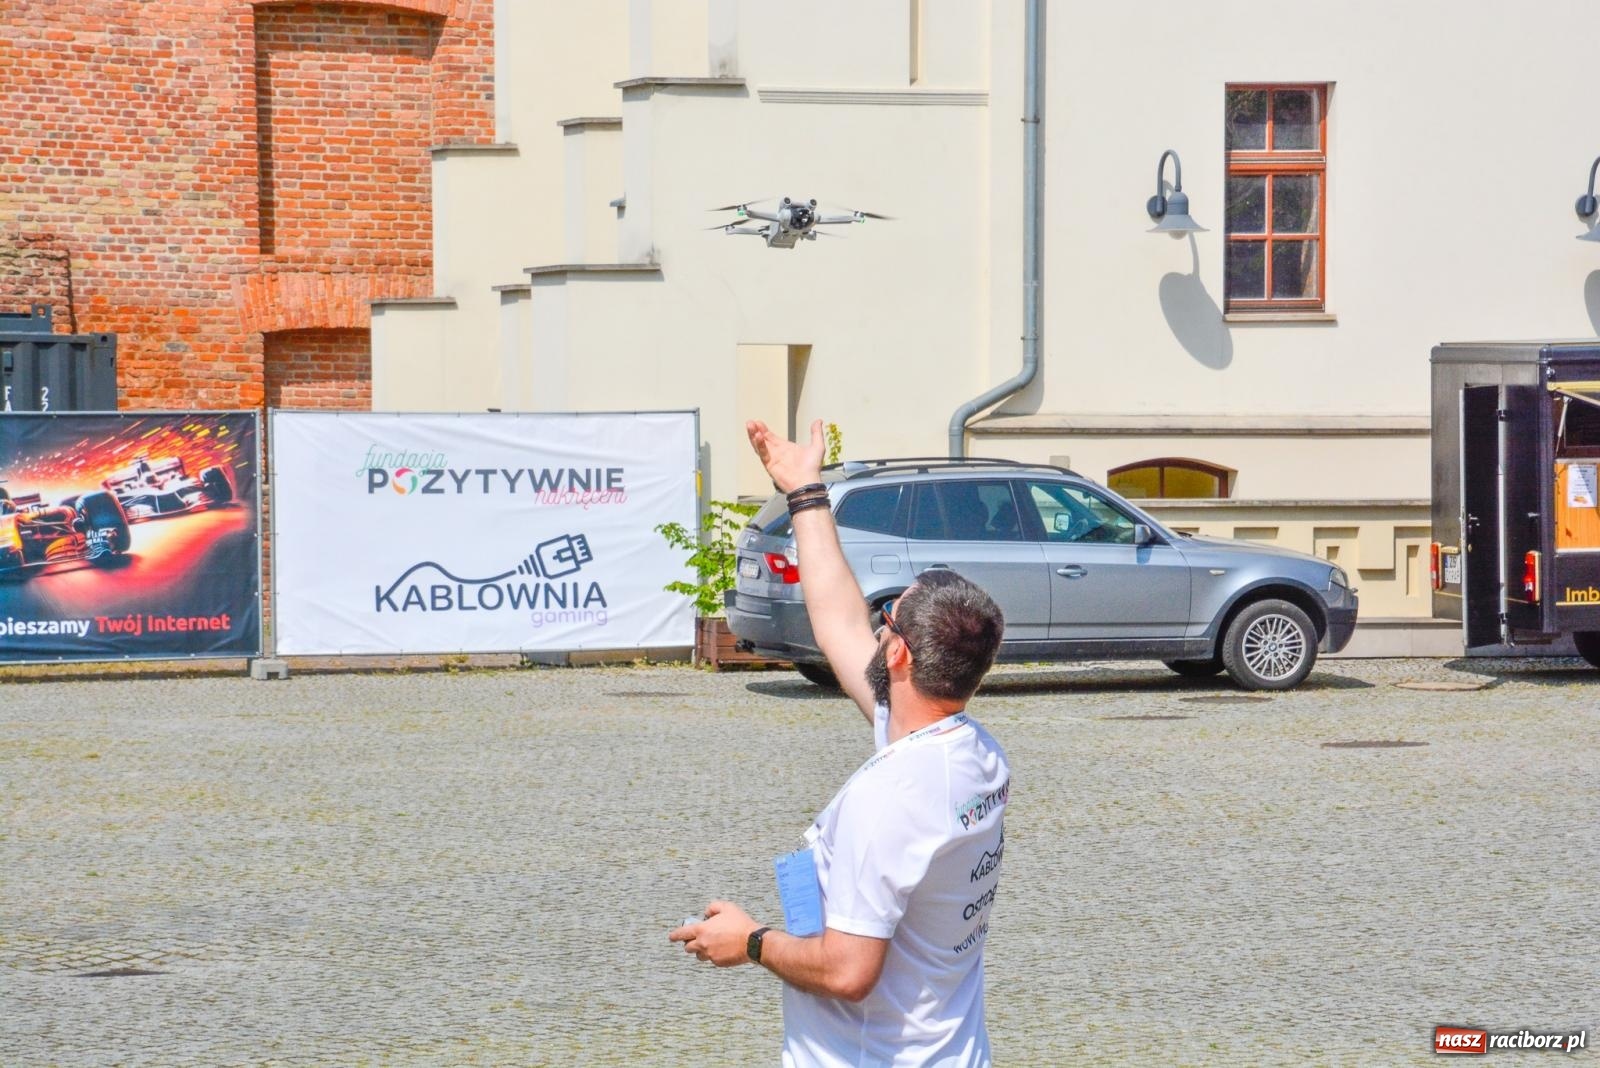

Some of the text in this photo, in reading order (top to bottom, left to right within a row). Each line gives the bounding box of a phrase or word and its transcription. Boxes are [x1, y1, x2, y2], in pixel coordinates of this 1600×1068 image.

[356, 443, 448, 477] fundacja
[367, 467, 625, 495] POZYTYWNIE
[375, 581, 608, 613] KABLOWNIA
[95, 614, 142, 636] Twój
[148, 613, 231, 632] Internet
[531, 610, 608, 628] gaming
